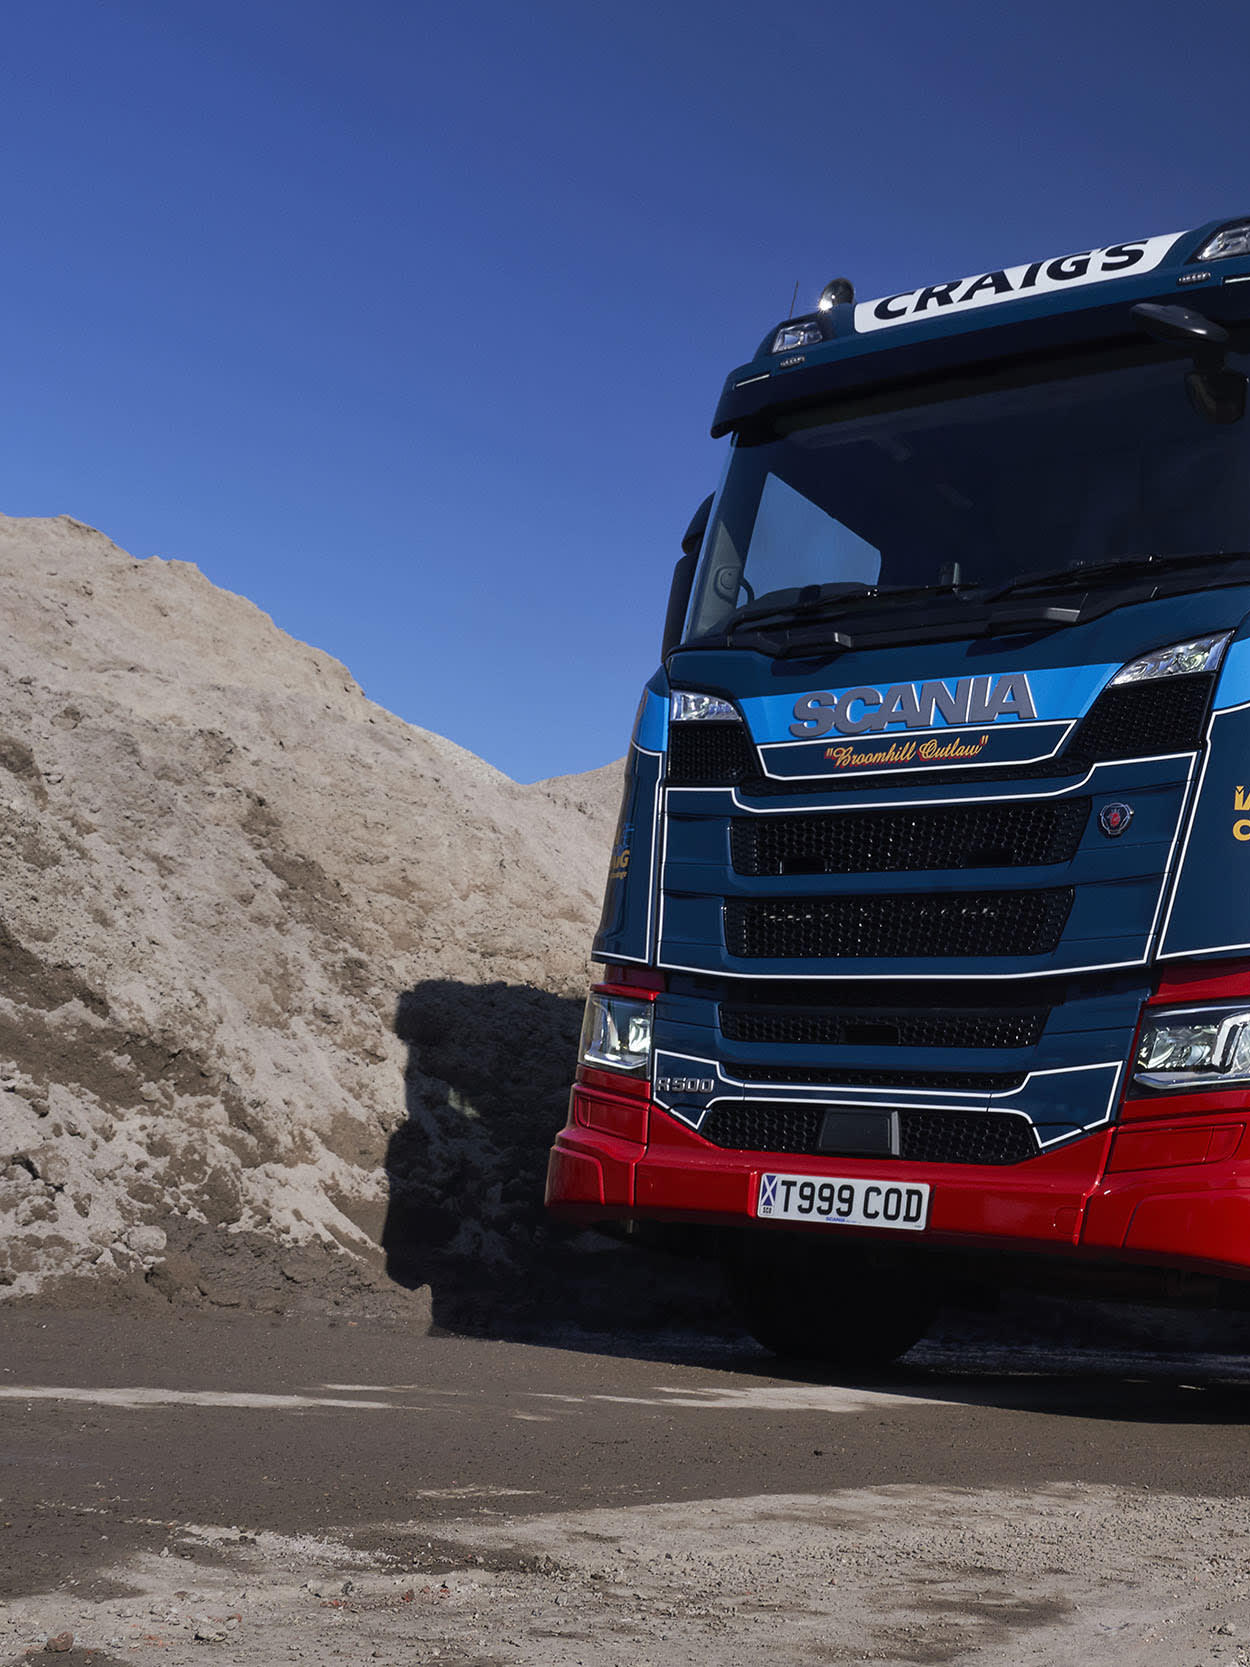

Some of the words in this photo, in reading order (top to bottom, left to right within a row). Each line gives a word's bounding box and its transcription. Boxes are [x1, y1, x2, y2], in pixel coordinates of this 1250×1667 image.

[789, 673, 1038, 738] SCANIA
[825, 740, 915, 768] "Broomhill
[919, 735, 989, 762] Outlaw"
[656, 1077, 714, 1093] R500
[780, 1180, 855, 1217] T999
[862, 1186, 924, 1223] COD
